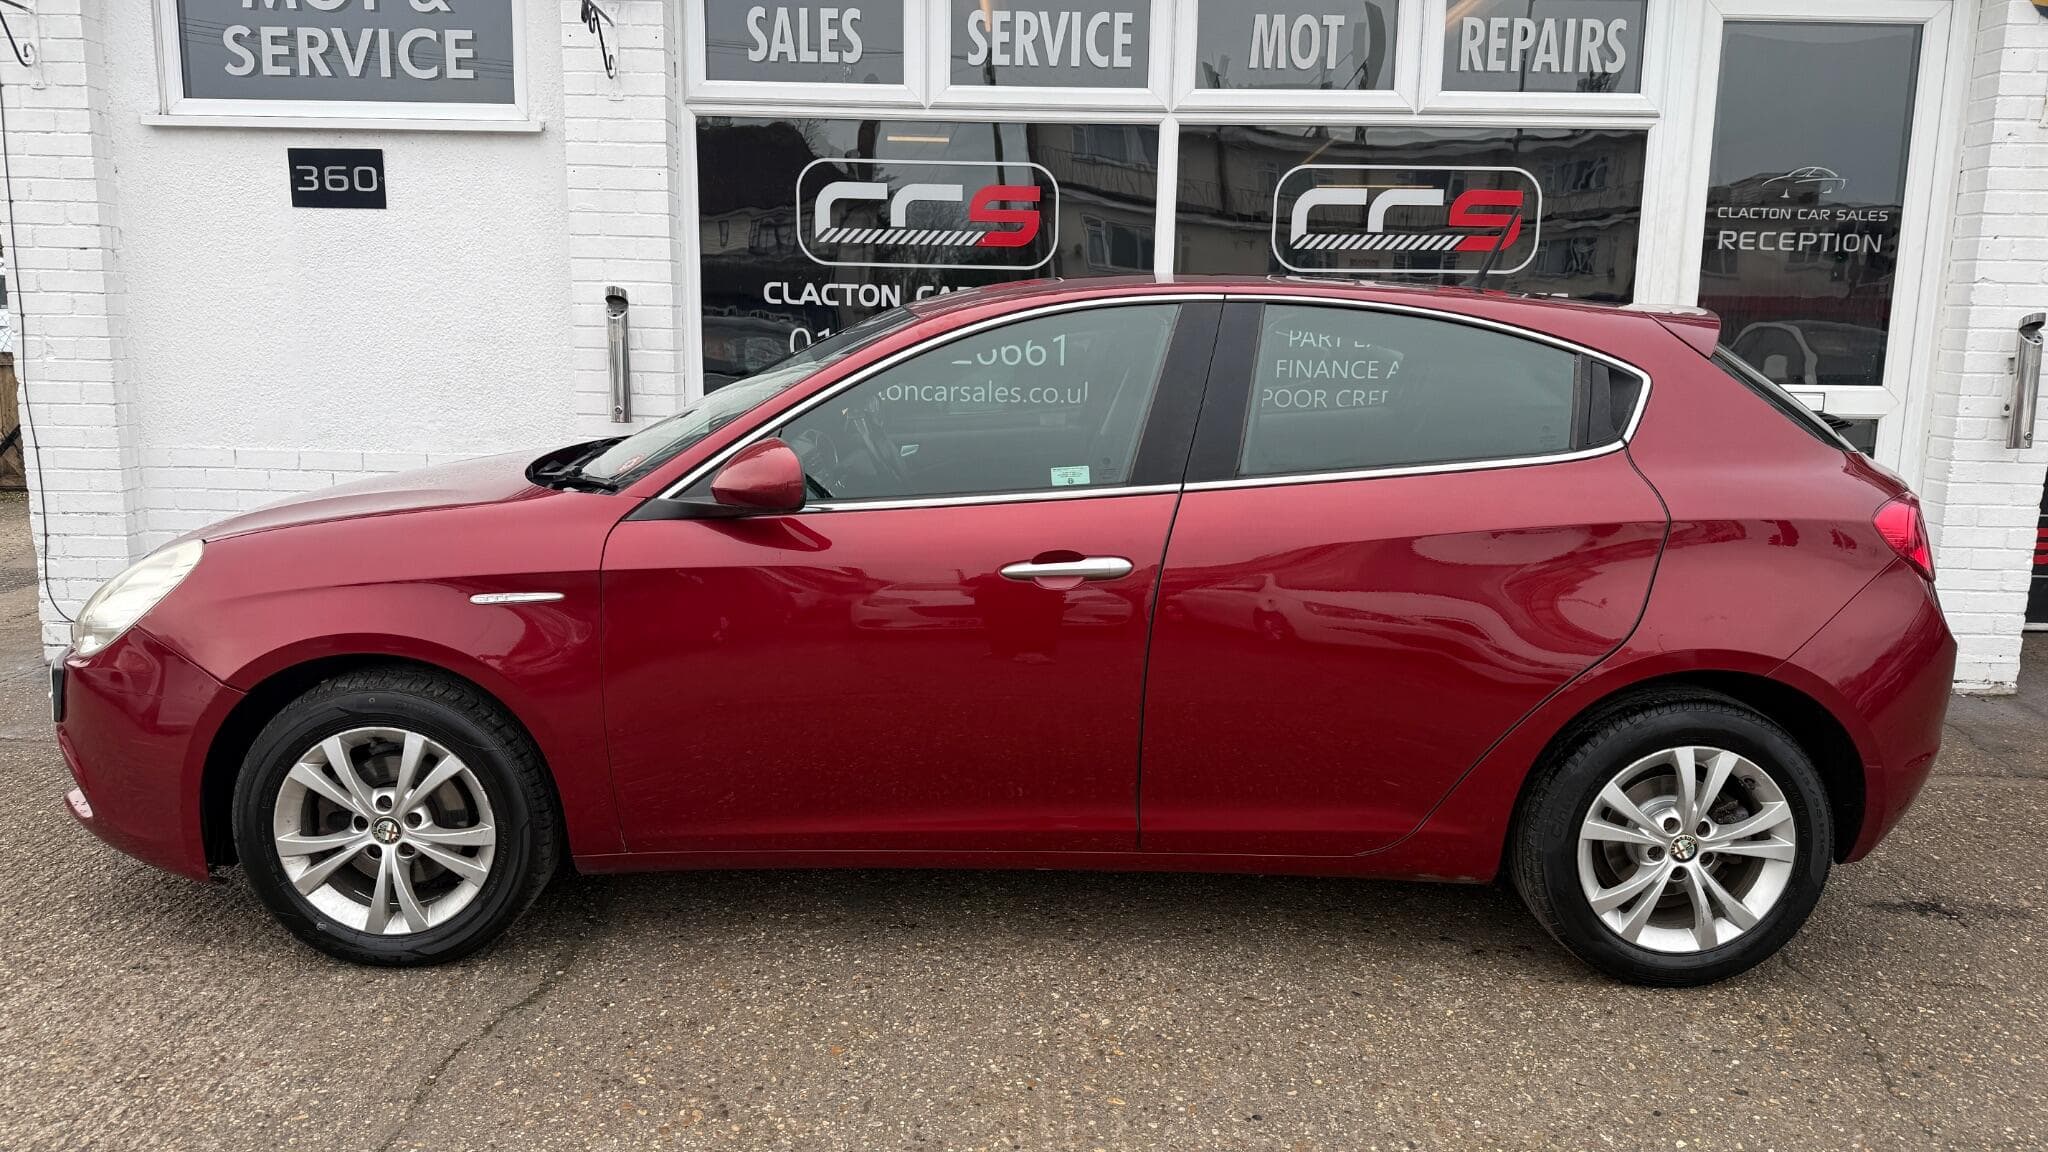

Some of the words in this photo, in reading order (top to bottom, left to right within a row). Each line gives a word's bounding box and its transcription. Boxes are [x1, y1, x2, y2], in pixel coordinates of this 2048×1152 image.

[747, 6, 863, 64] SALES
[967, 8, 1133, 68] SERVICE
[1249, 14, 1345, 69] MOT
[1459, 17, 1627, 73] REPAIRS
[222, 24, 475, 79] SERVICE
[295, 165, 378, 192] 360
[1717, 206, 1792, 220] CLACTON
[1797, 208, 1831, 221] CAR
[1836, 209, 1889, 222] SALES
[1717, 230, 1882, 253] RECEPTION
[763, 281, 900, 307] CLACTON
[1276, 359, 1379, 380] FINANCE
[1262, 388, 1328, 409] POOR
